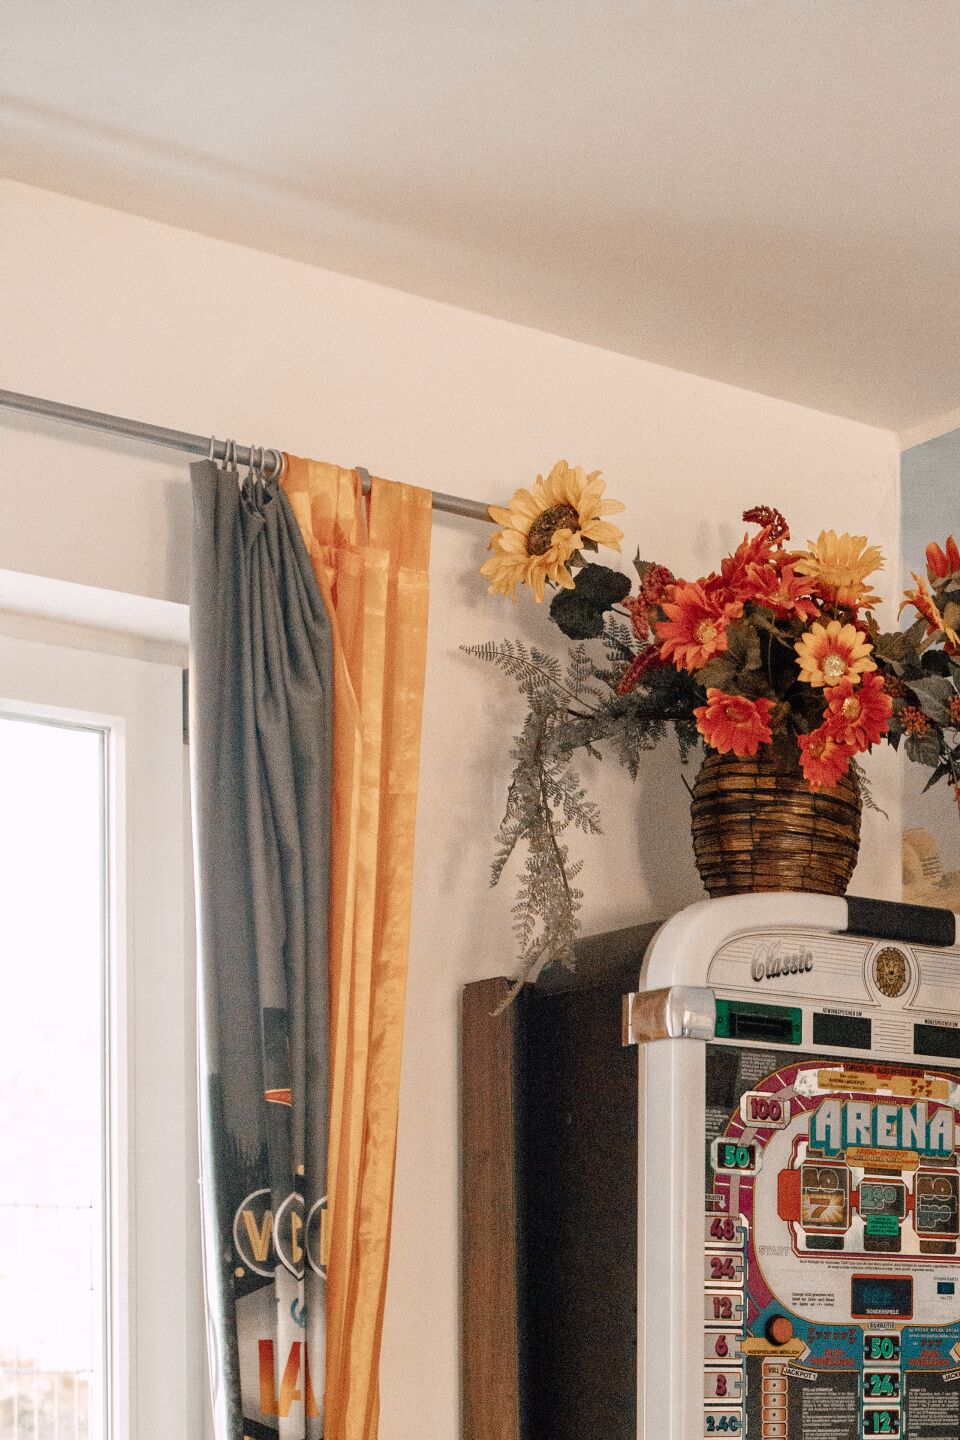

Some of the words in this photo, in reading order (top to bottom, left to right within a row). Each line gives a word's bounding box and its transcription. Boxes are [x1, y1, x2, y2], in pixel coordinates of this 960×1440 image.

[751, 939, 813, 982] Classic
[750, 1097, 782, 1121] 100
[810, 1099, 955, 1156] ARENA
[724, 1145, 750, 1168] 50
[809, 1197, 831, 1219] 7
[710, 1217, 735, 1241] 48
[758, 1245, 789, 1257] START
[710, 1257, 736, 1280] 24
[713, 1296, 733, 1319] 12
[715, 1335, 728, 1358] 6
[870, 1337, 894, 1359] 50
[783, 1367, 812, 1378] JACKPOT
[716, 1374, 727, 1396] 3
[870, 1374, 894, 1396] 24
[706, 1415, 739, 1432] 2.40
[873, 1412, 892, 1434] 12
